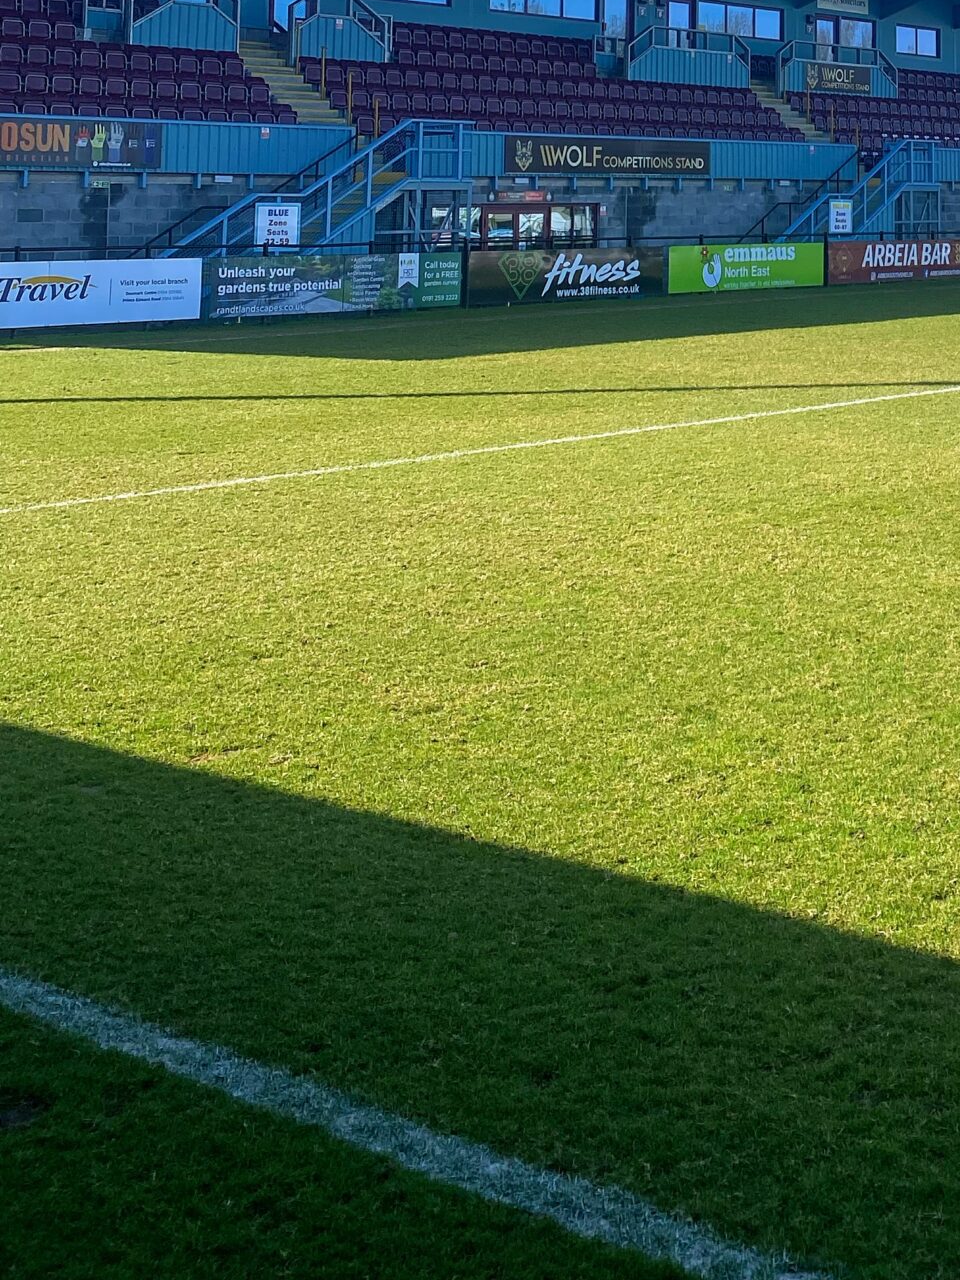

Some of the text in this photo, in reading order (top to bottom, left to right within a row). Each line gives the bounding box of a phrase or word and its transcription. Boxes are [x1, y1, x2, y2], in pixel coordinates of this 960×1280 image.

[603, 156, 673, 169] COMPETITIONS
[676, 158, 705, 169] STAND
[268, 209, 289, 217] BLUE
[268, 219, 288, 227] Zone
[266, 228, 288, 236] Seats
[724, 246, 796, 263] emmaus
[862, 243, 950, 268] ARBEIA BAR
[424, 260, 459, 269] Call today
[218, 266, 295, 279] Unleash your
[424, 271, 434, 279] for
[541, 253, 641, 297] fitness
[724, 266, 770, 278] North East
[0, 274, 92, 303] Travel
[120, 277, 188, 288] Visit your local branch
[217, 279, 341, 296] gardens true potential
[556, 283, 640, 297] www.38fitness.co.uk
[216, 303, 305, 315] randtlandscapes.co.uk
